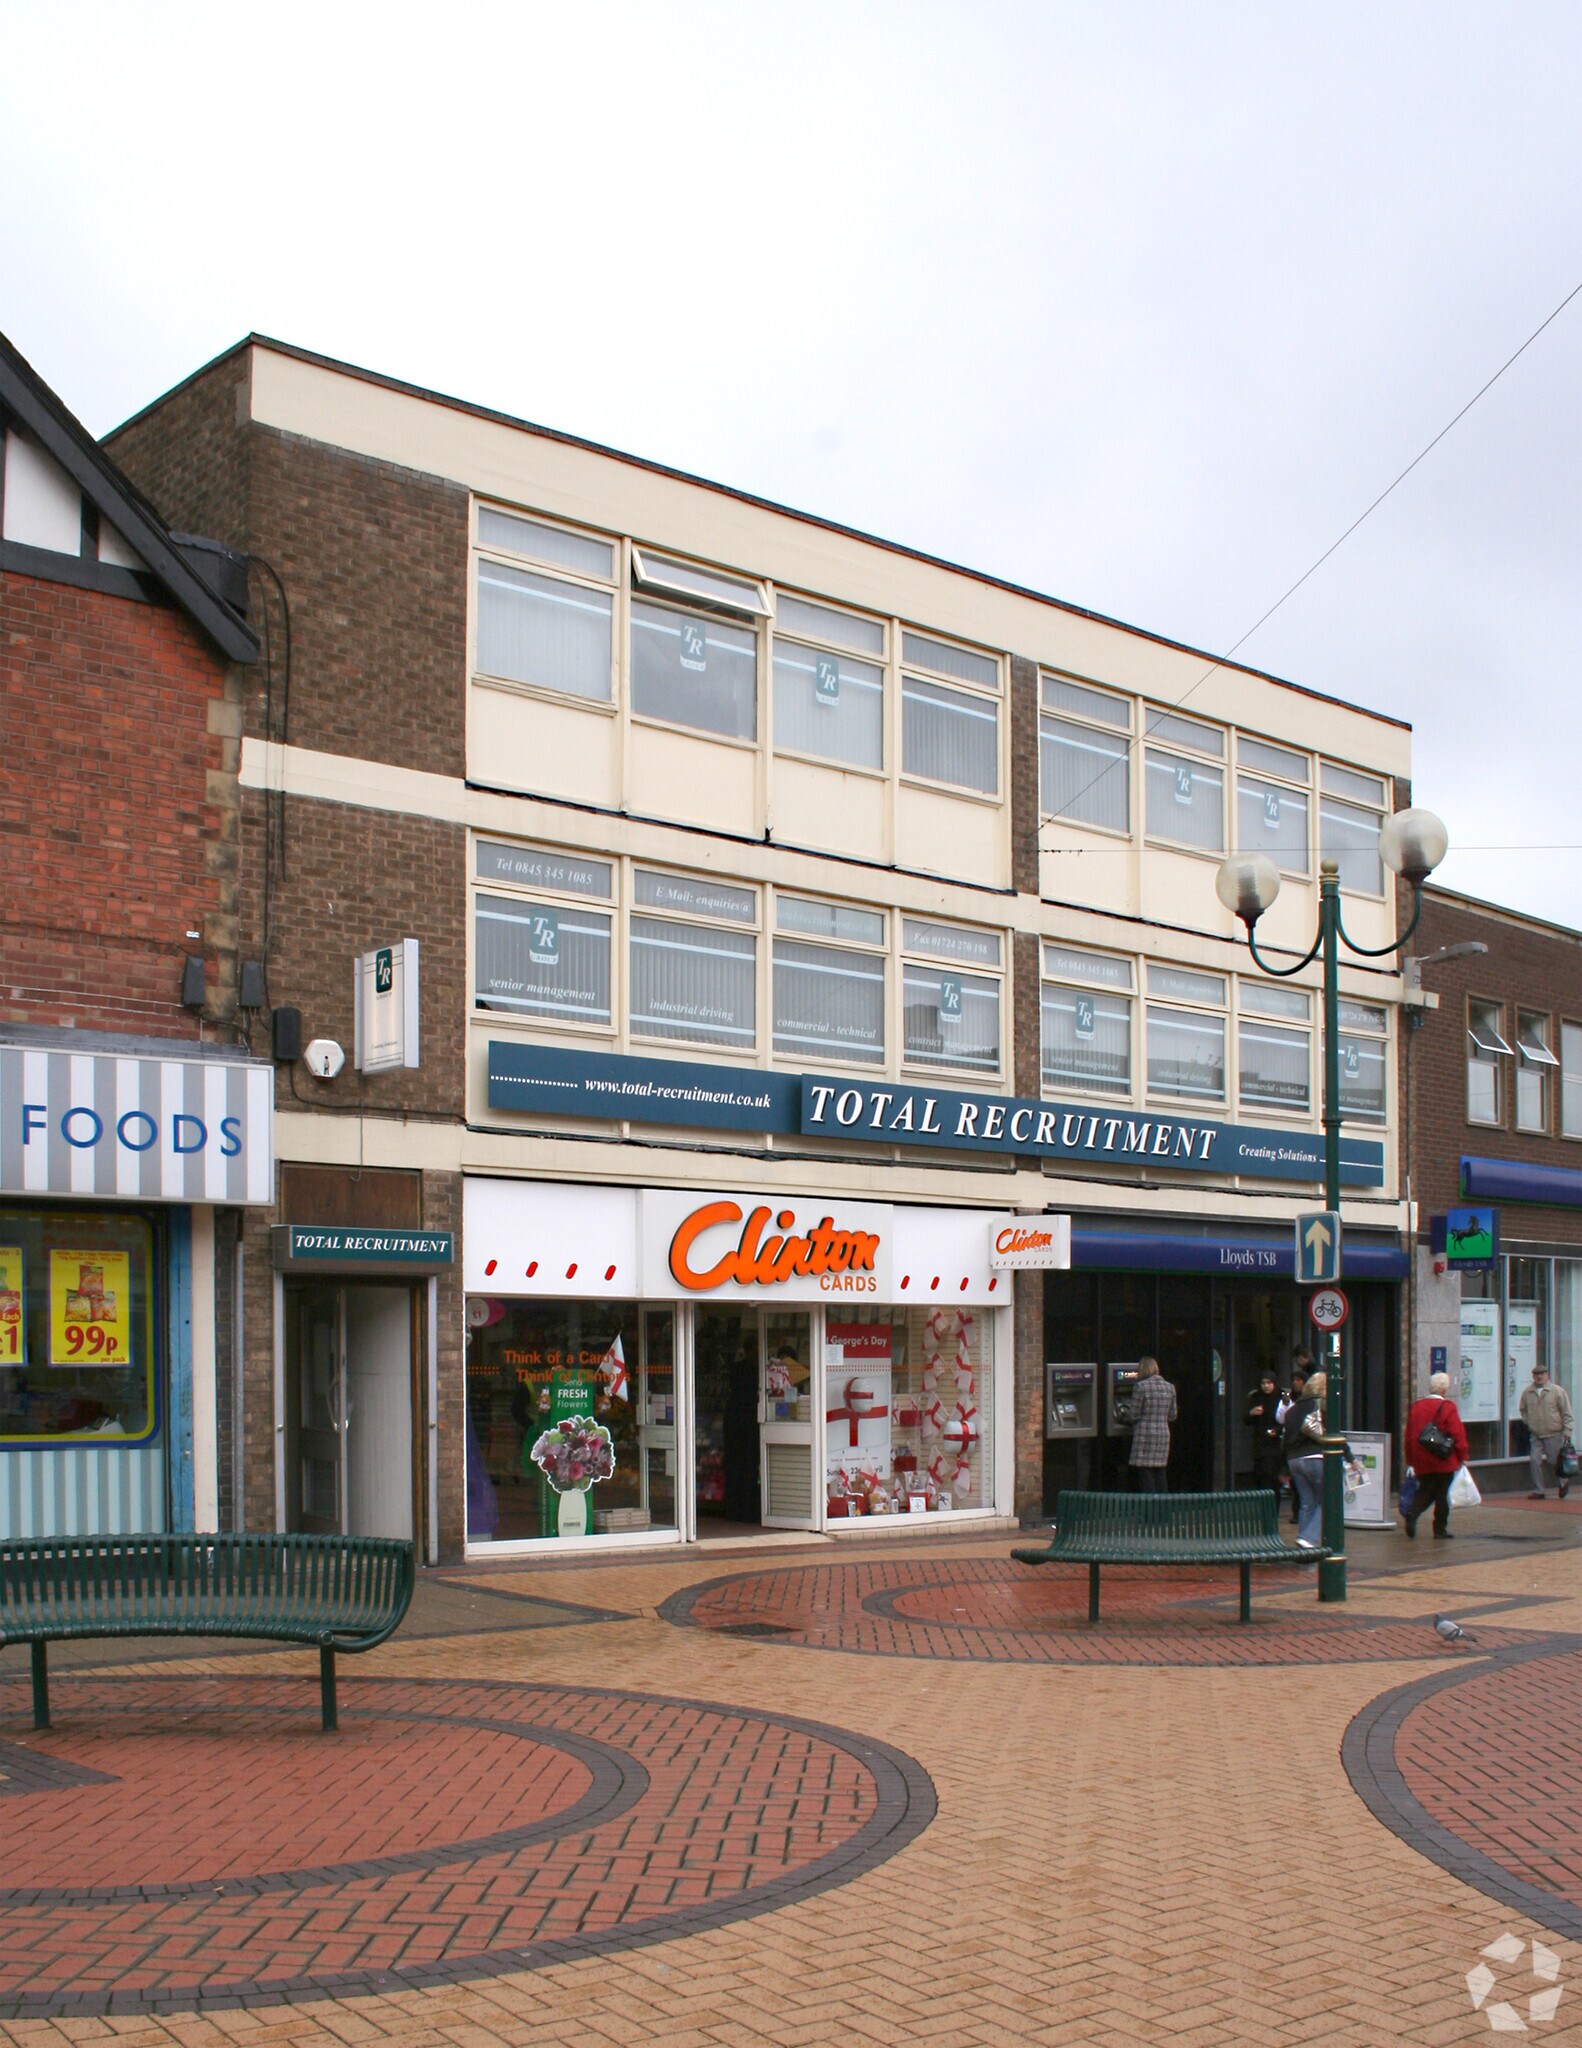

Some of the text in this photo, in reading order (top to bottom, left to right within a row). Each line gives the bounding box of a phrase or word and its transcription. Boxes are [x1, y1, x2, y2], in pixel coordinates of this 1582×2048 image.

[683, 625, 703, 656] TR
[819, 661, 836, 692] TR
[1177, 768, 1190, 792] TR
[1266, 793, 1278, 816] TR
[496, 858, 593, 886] Tel 0845 345 1085
[656, 886, 664, 897] E
[667, 888, 693, 903] Mail:
[534, 917, 555, 948] TR
[914, 933, 930, 944] Fax
[931, 936, 956, 949] 01724
[974, 941, 988, 954] 198
[378, 957, 391, 986] TR
[489, 978, 596, 1001] senior management
[943, 982, 959, 1009] TR
[650, 999, 734, 1022] industrial driving
[1079, 1001, 1092, 1026] TR
[777, 1017, 829, 1034] commercial
[837, 1025, 876, 1039] technical
[908, 1035, 993, 1053] contract management
[1347, 1045, 1357, 1067] TR
[585, 1077, 771, 1108] www.total-recruitment.co.uk
[22, 1104, 243, 1157] FOODS
[810, 1086, 1218, 1161] TOTAL RECRUITMENT
[1238, 1144, 1317, 1162] Creating Solutions
[295, 1235, 448, 1253] TOTAL RECRUITMENT
[668, 1200, 881, 1291] Clinton
[996, 1228, 1053, 1254] Clinton
[1220, 1248, 1277, 1269] Lloyds TSB
[820, 1275, 877, 1292] CARDS
[2, 1313, 19, 1321] Each
[65, 1325, 118, 1356] 99p
[831, 1335, 869, 1348] George's
[871, 1336, 888, 1348] Day
[504, 1350, 542, 1364] Think
[547, 1350, 560, 1364] of
[566, 1353, 574, 1364] a
[516, 1369, 553, 1382] Think
[558, 1369, 572, 1382] of
[557, 1389, 588, 1399] FRESH
